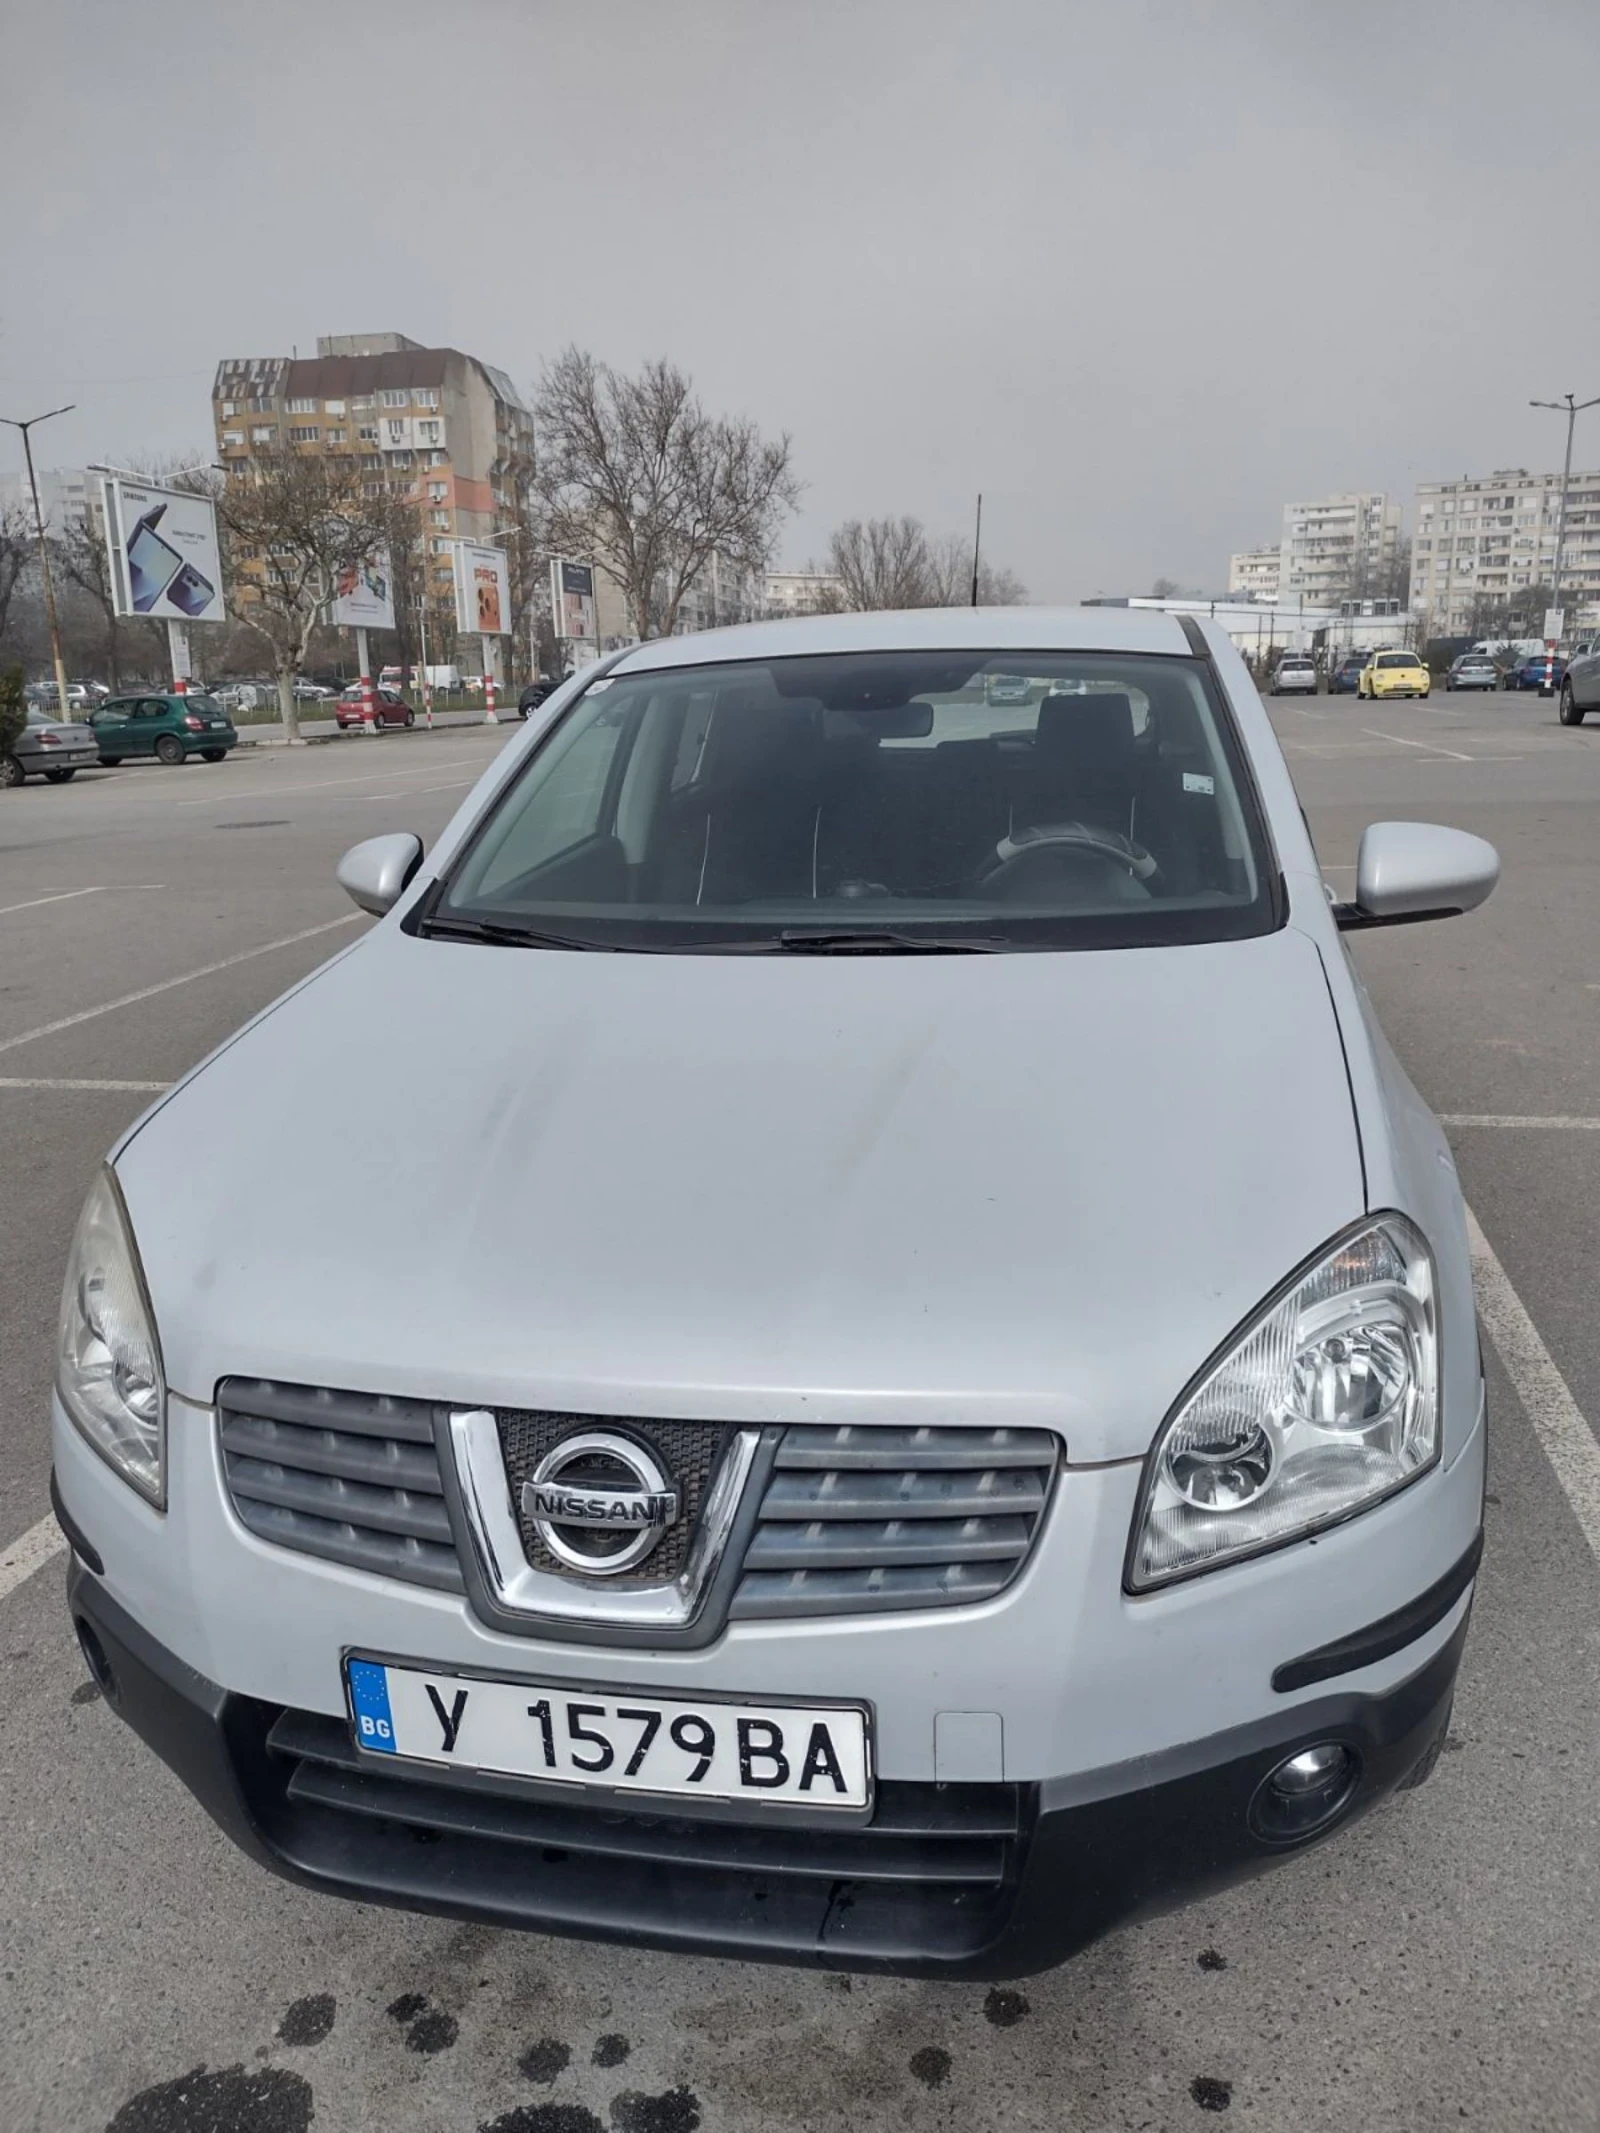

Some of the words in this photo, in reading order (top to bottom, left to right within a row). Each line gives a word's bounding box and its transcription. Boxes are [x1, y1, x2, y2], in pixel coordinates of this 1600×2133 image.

[123, 491, 147, 502] SAMSUNG
[473, 566, 498, 583] PRO
[535, 1493, 655, 1521] NISSAN
[360, 1715, 391, 1738] BG
[527, 1699, 716, 1782] 1579
